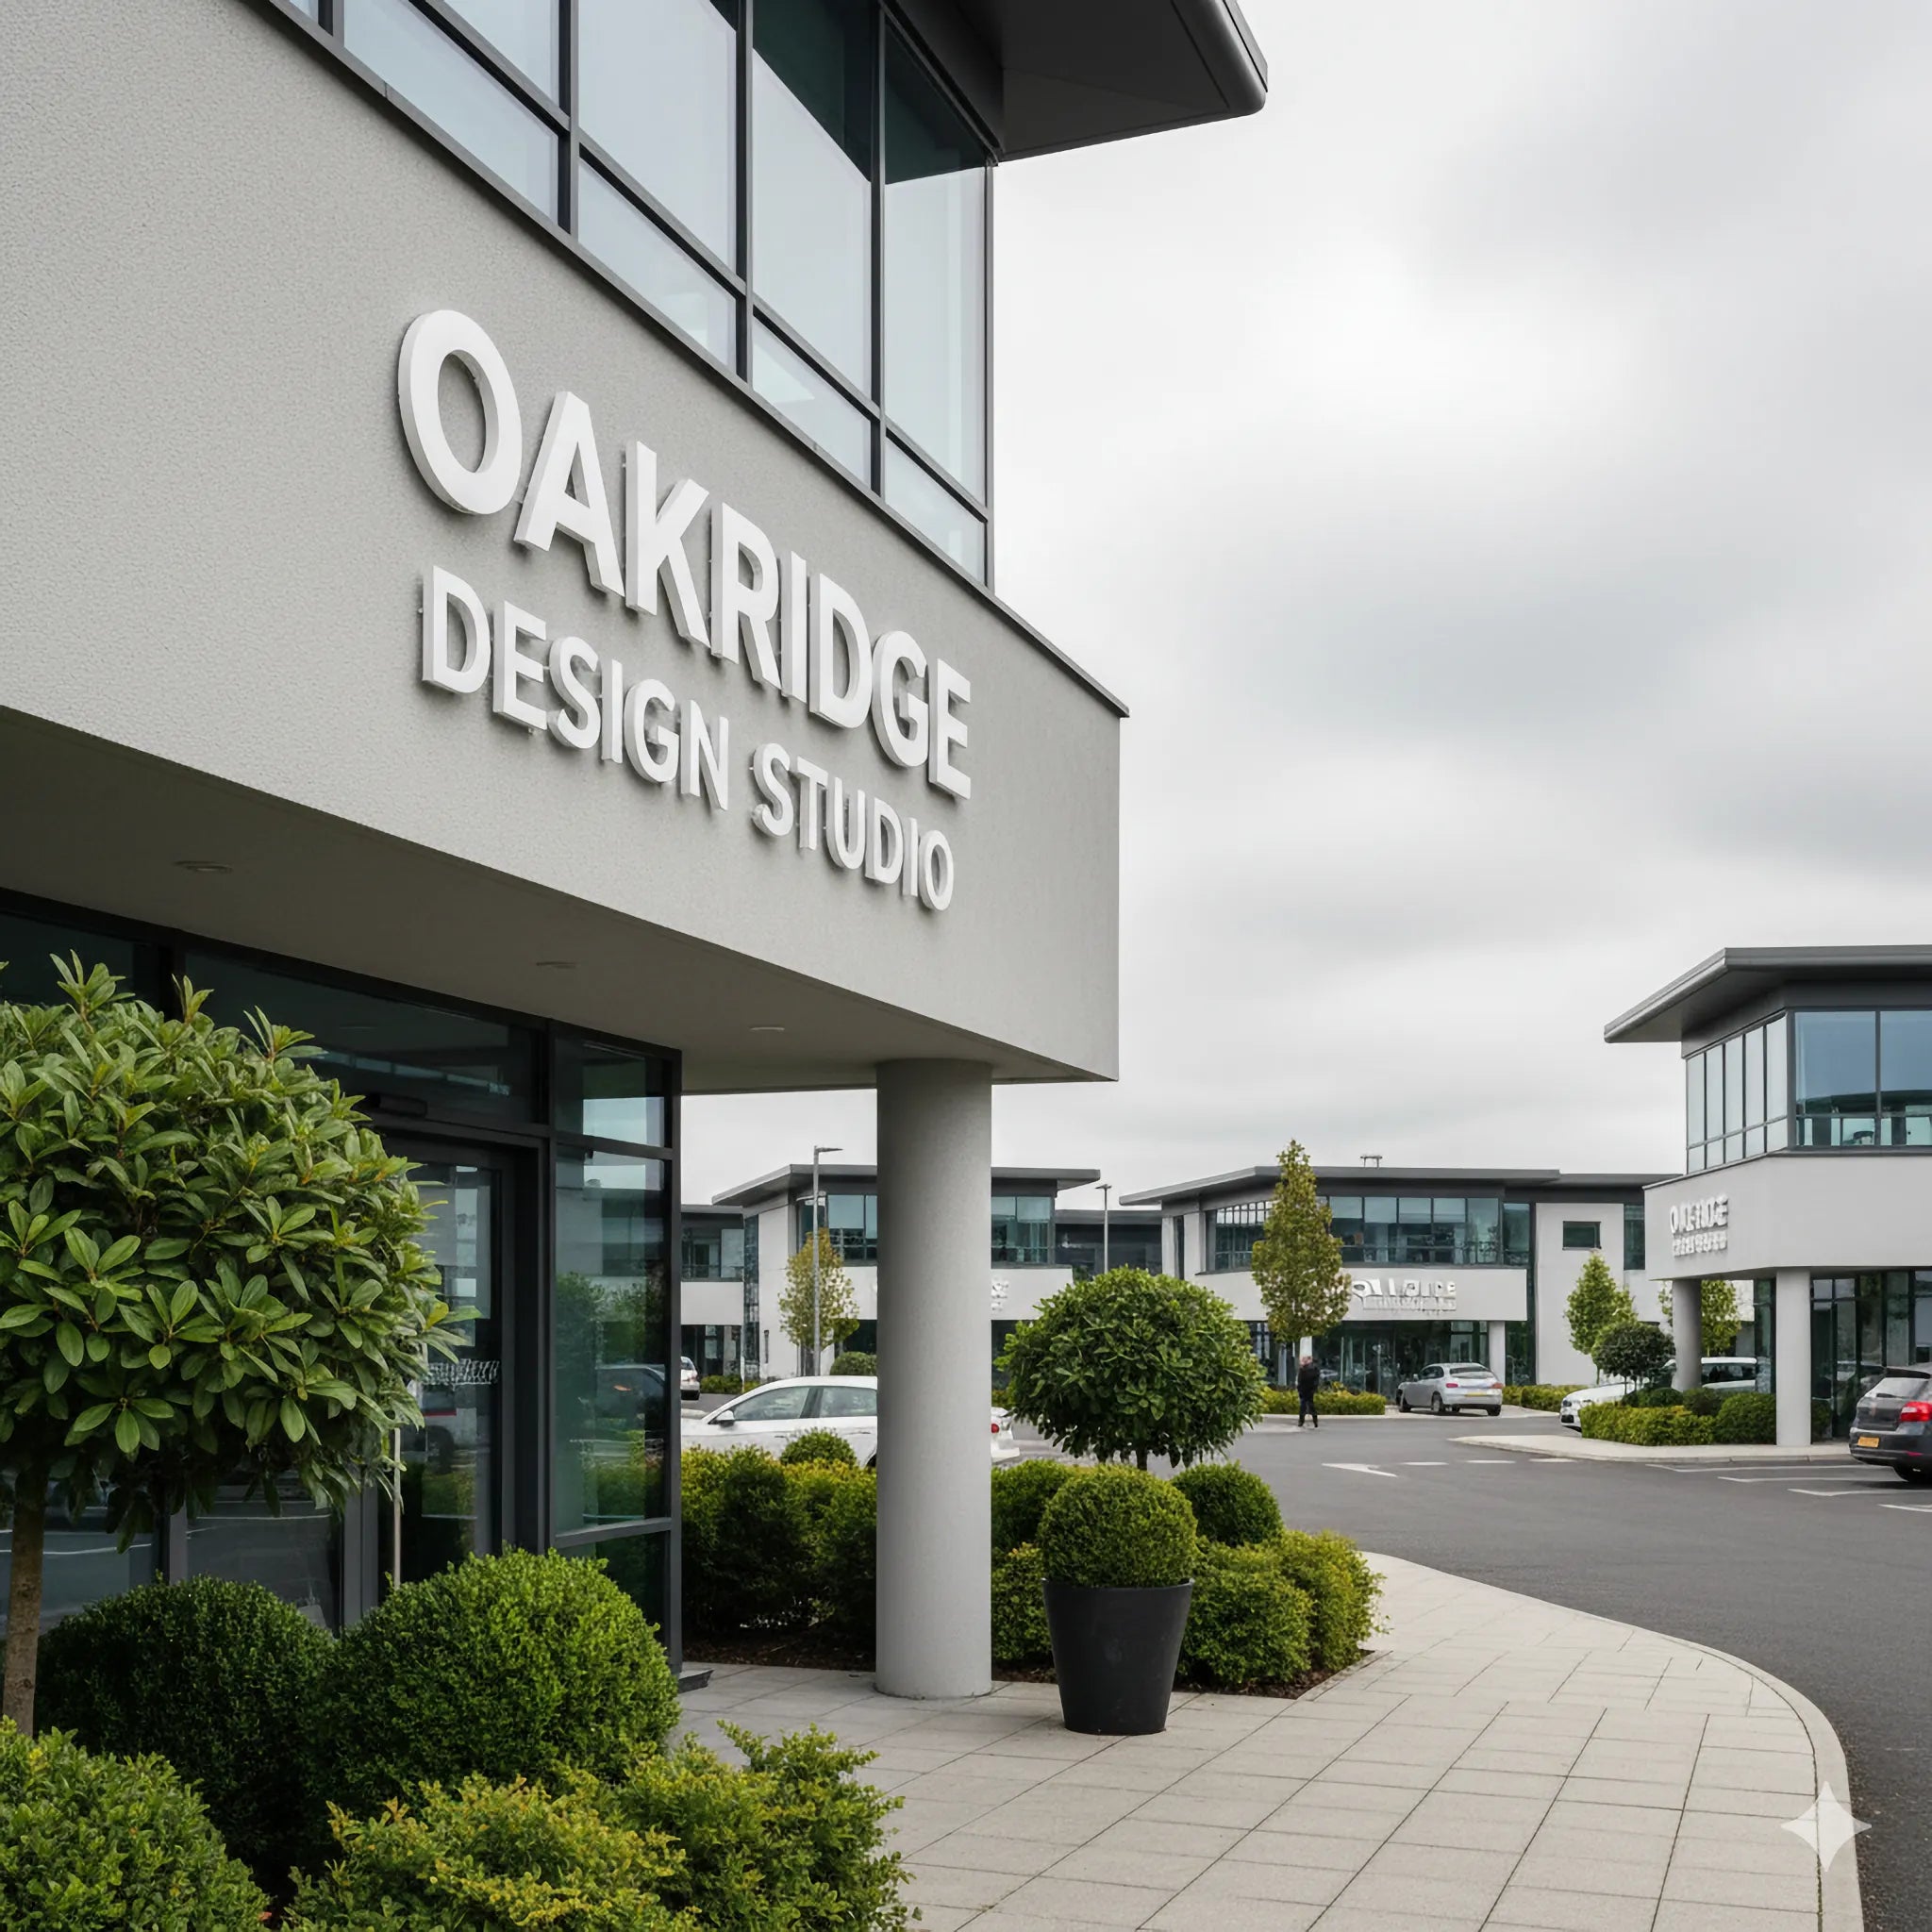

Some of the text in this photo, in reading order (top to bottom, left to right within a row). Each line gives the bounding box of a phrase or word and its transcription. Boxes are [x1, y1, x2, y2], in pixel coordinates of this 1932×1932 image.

[398, 309, 971, 800] OAKRIDGE
[422, 565, 954, 911] DESIGN STUDIO
